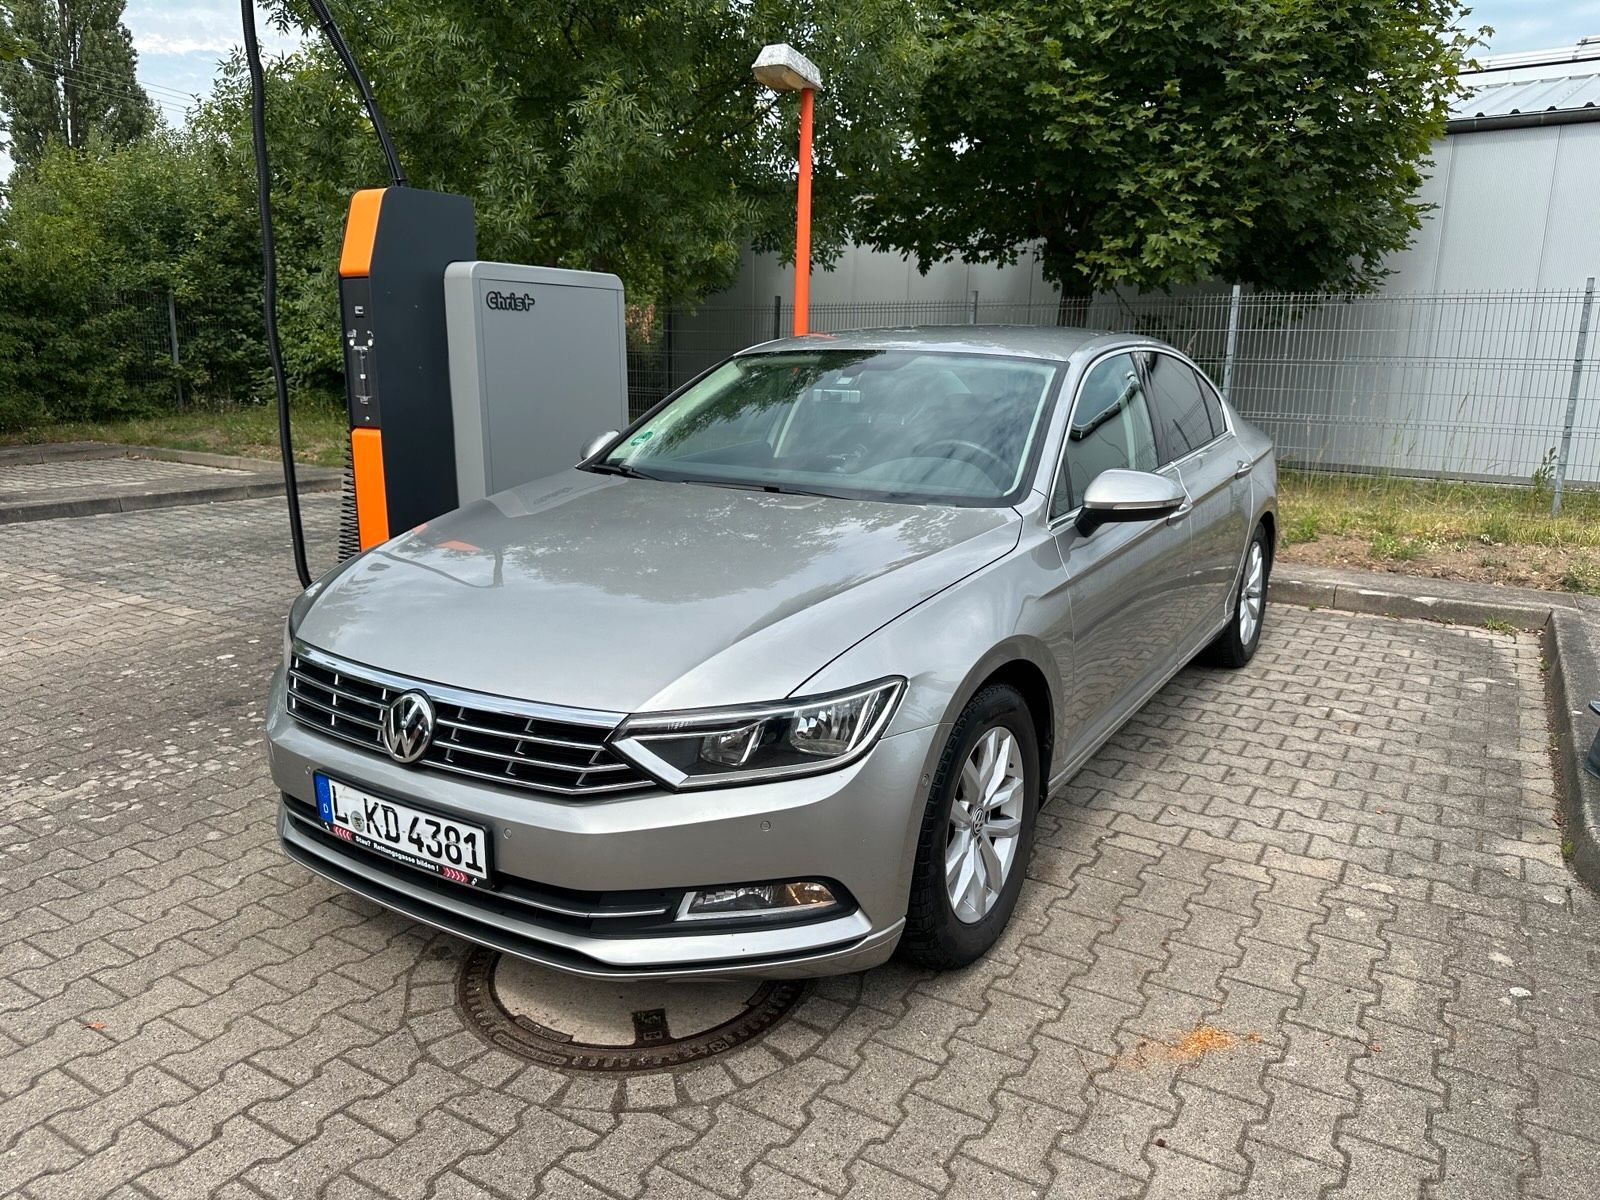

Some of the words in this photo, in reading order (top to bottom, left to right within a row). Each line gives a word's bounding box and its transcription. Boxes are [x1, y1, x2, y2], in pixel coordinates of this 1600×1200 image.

[486, 291, 535, 311] Christ
[323, 803, 329, 814] D
[332, 785, 349, 825] L
[363, 798, 401, 843] KD
[407, 816, 484, 873] 4381
